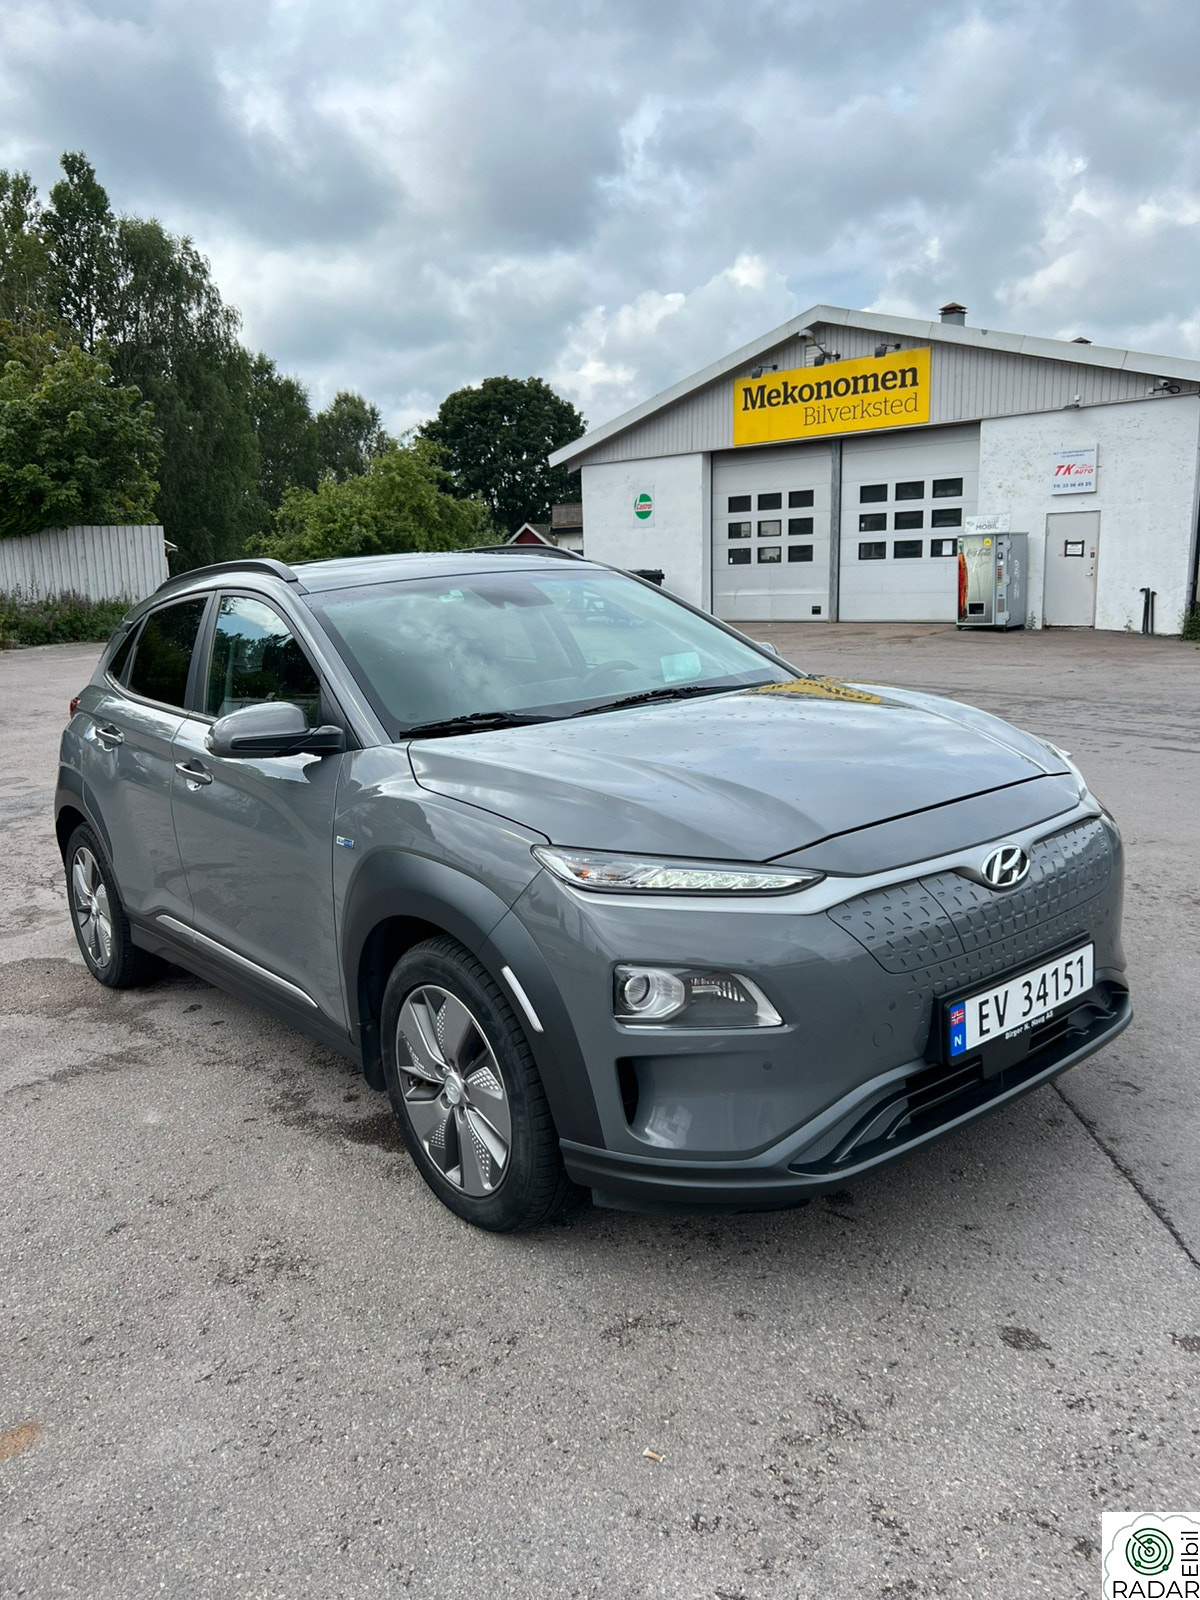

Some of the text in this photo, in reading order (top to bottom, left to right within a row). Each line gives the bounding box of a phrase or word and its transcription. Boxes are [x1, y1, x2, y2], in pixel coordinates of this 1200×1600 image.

[742, 366, 919, 411] Mekonomen
[803, 392, 919, 426] Bilverksted
[1054, 463, 1076, 477] TK
[978, 954, 1085, 1038] EV 34151
[954, 1034, 963, 1048] N
